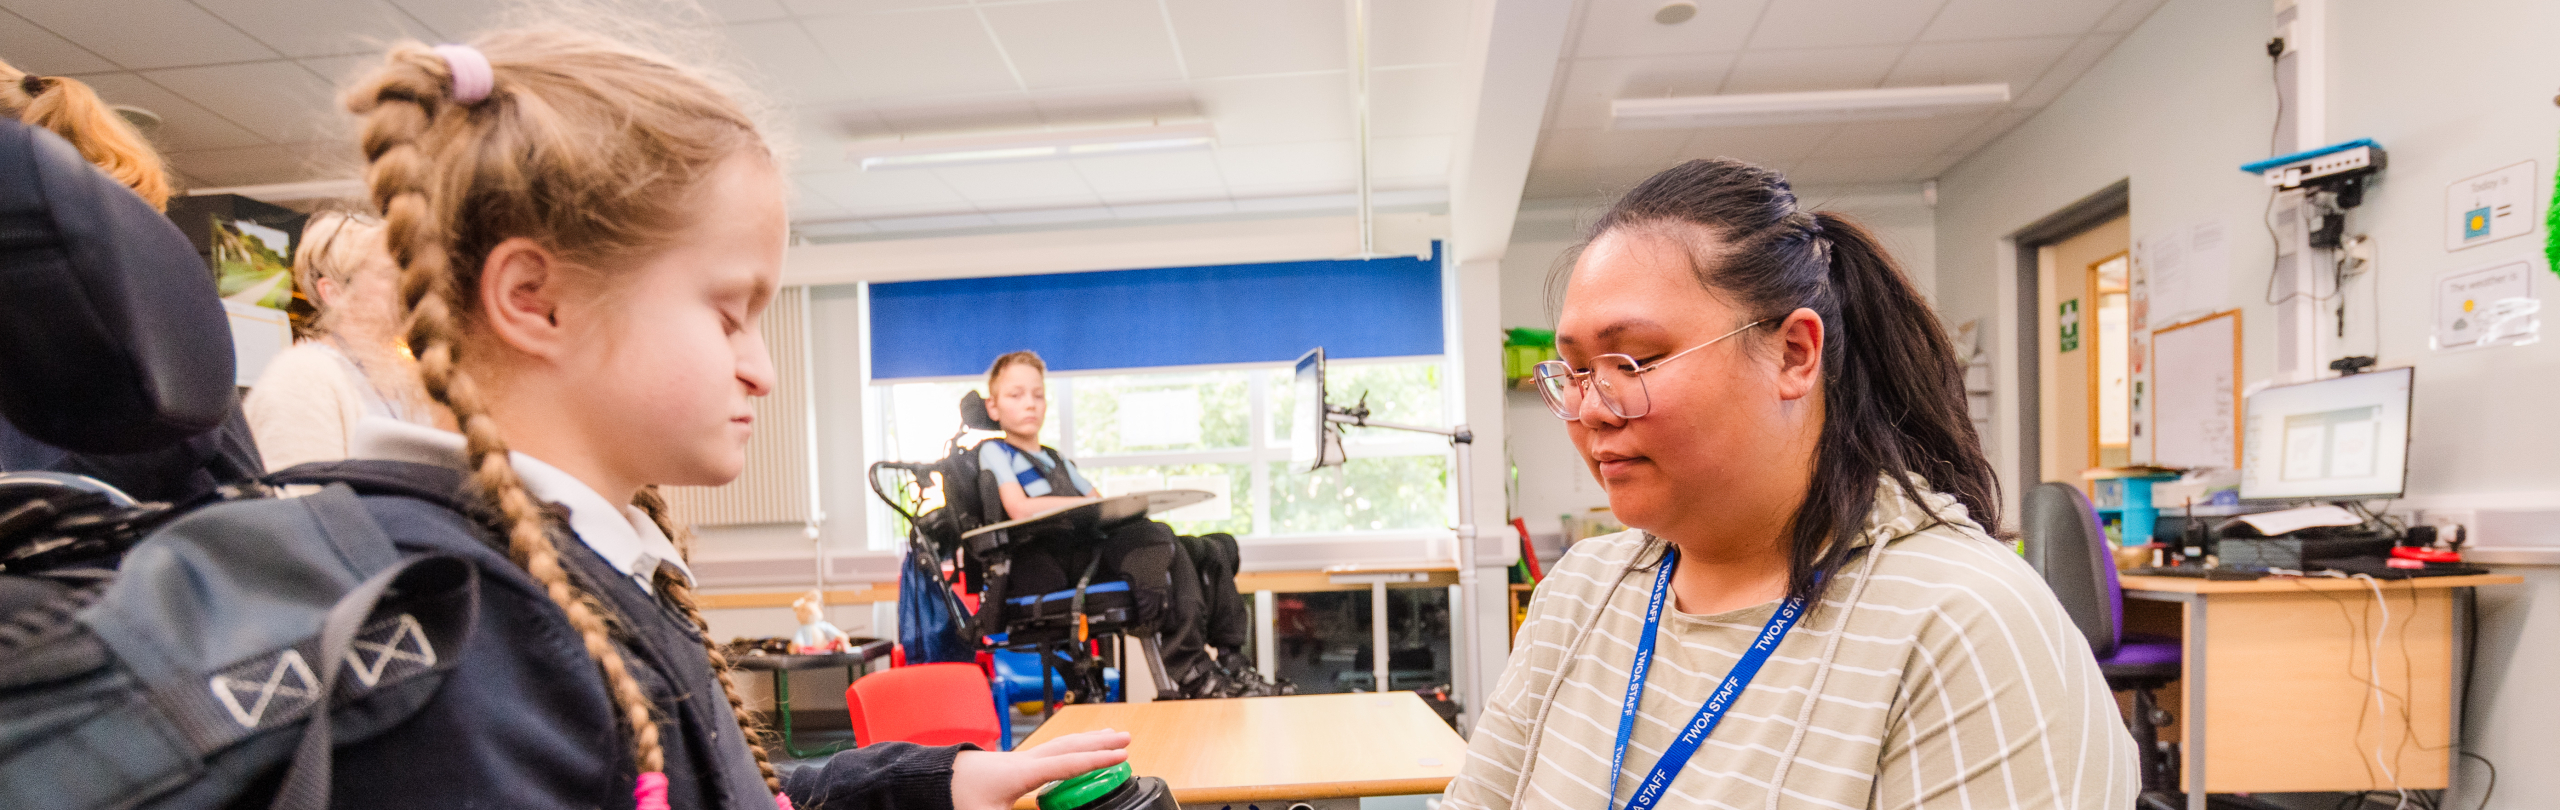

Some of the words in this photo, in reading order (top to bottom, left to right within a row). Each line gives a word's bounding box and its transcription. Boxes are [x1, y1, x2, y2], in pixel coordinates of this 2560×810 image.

[1655, 562, 1671, 592] TWOA
[1647, 592, 1662, 623] STAFF
[1754, 619, 1788, 651] TWOA
[1783, 591, 1807, 618] STA
[1632, 649, 1648, 682] TWOA
[1624, 683, 1639, 716] STAFF
[1682, 711, 1714, 745] TWOA
[1709, 676, 1739, 712] STAFF
[1638, 768, 1667, 806] STAFF
